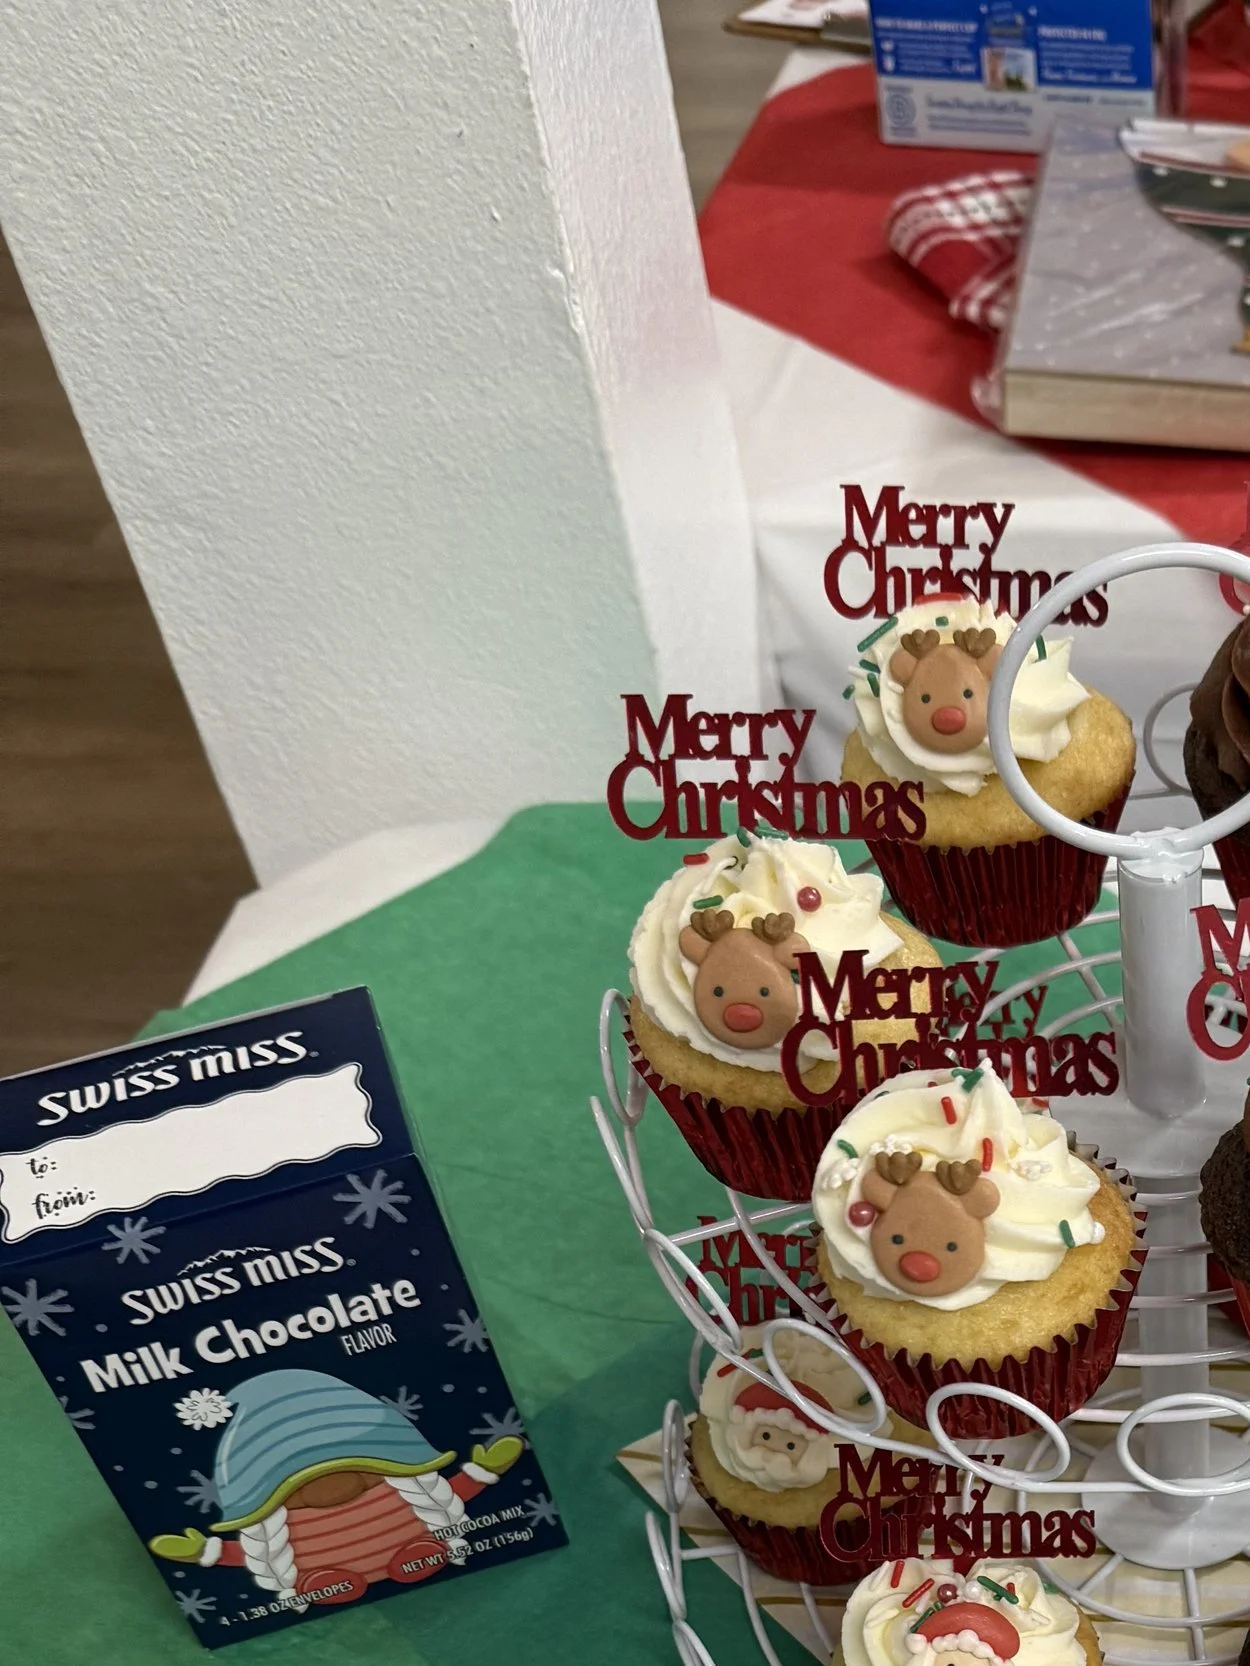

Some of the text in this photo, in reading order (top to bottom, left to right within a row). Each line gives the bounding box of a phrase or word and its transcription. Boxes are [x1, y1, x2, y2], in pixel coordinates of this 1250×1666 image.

[840, 484, 1015, 556] Merry
[619, 694, 816, 770] Merry
[606, 758, 927, 841] Christmas
[793, 949, 999, 1022] Merry
[25, 1156, 58, 1179] to:
[31, 1190, 96, 1220] from:
[79, 1279, 421, 1393] Milk Chocolate
[340, 1323, 397, 1356] FLAVOR
[402, 1527, 534, 1574] NET WT 5.52 OZ (156g)
[434, 1505, 526, 1541] HOT COCOA MIX
[819, 1494, 1097, 1563] Christmas
[220, 1615, 231, 1627] 4
[241, 1606, 268, 1623] 1.38
[269, 1599, 288, 1615] OZ
[288, 1581, 353, 1608] ENVELOPES
